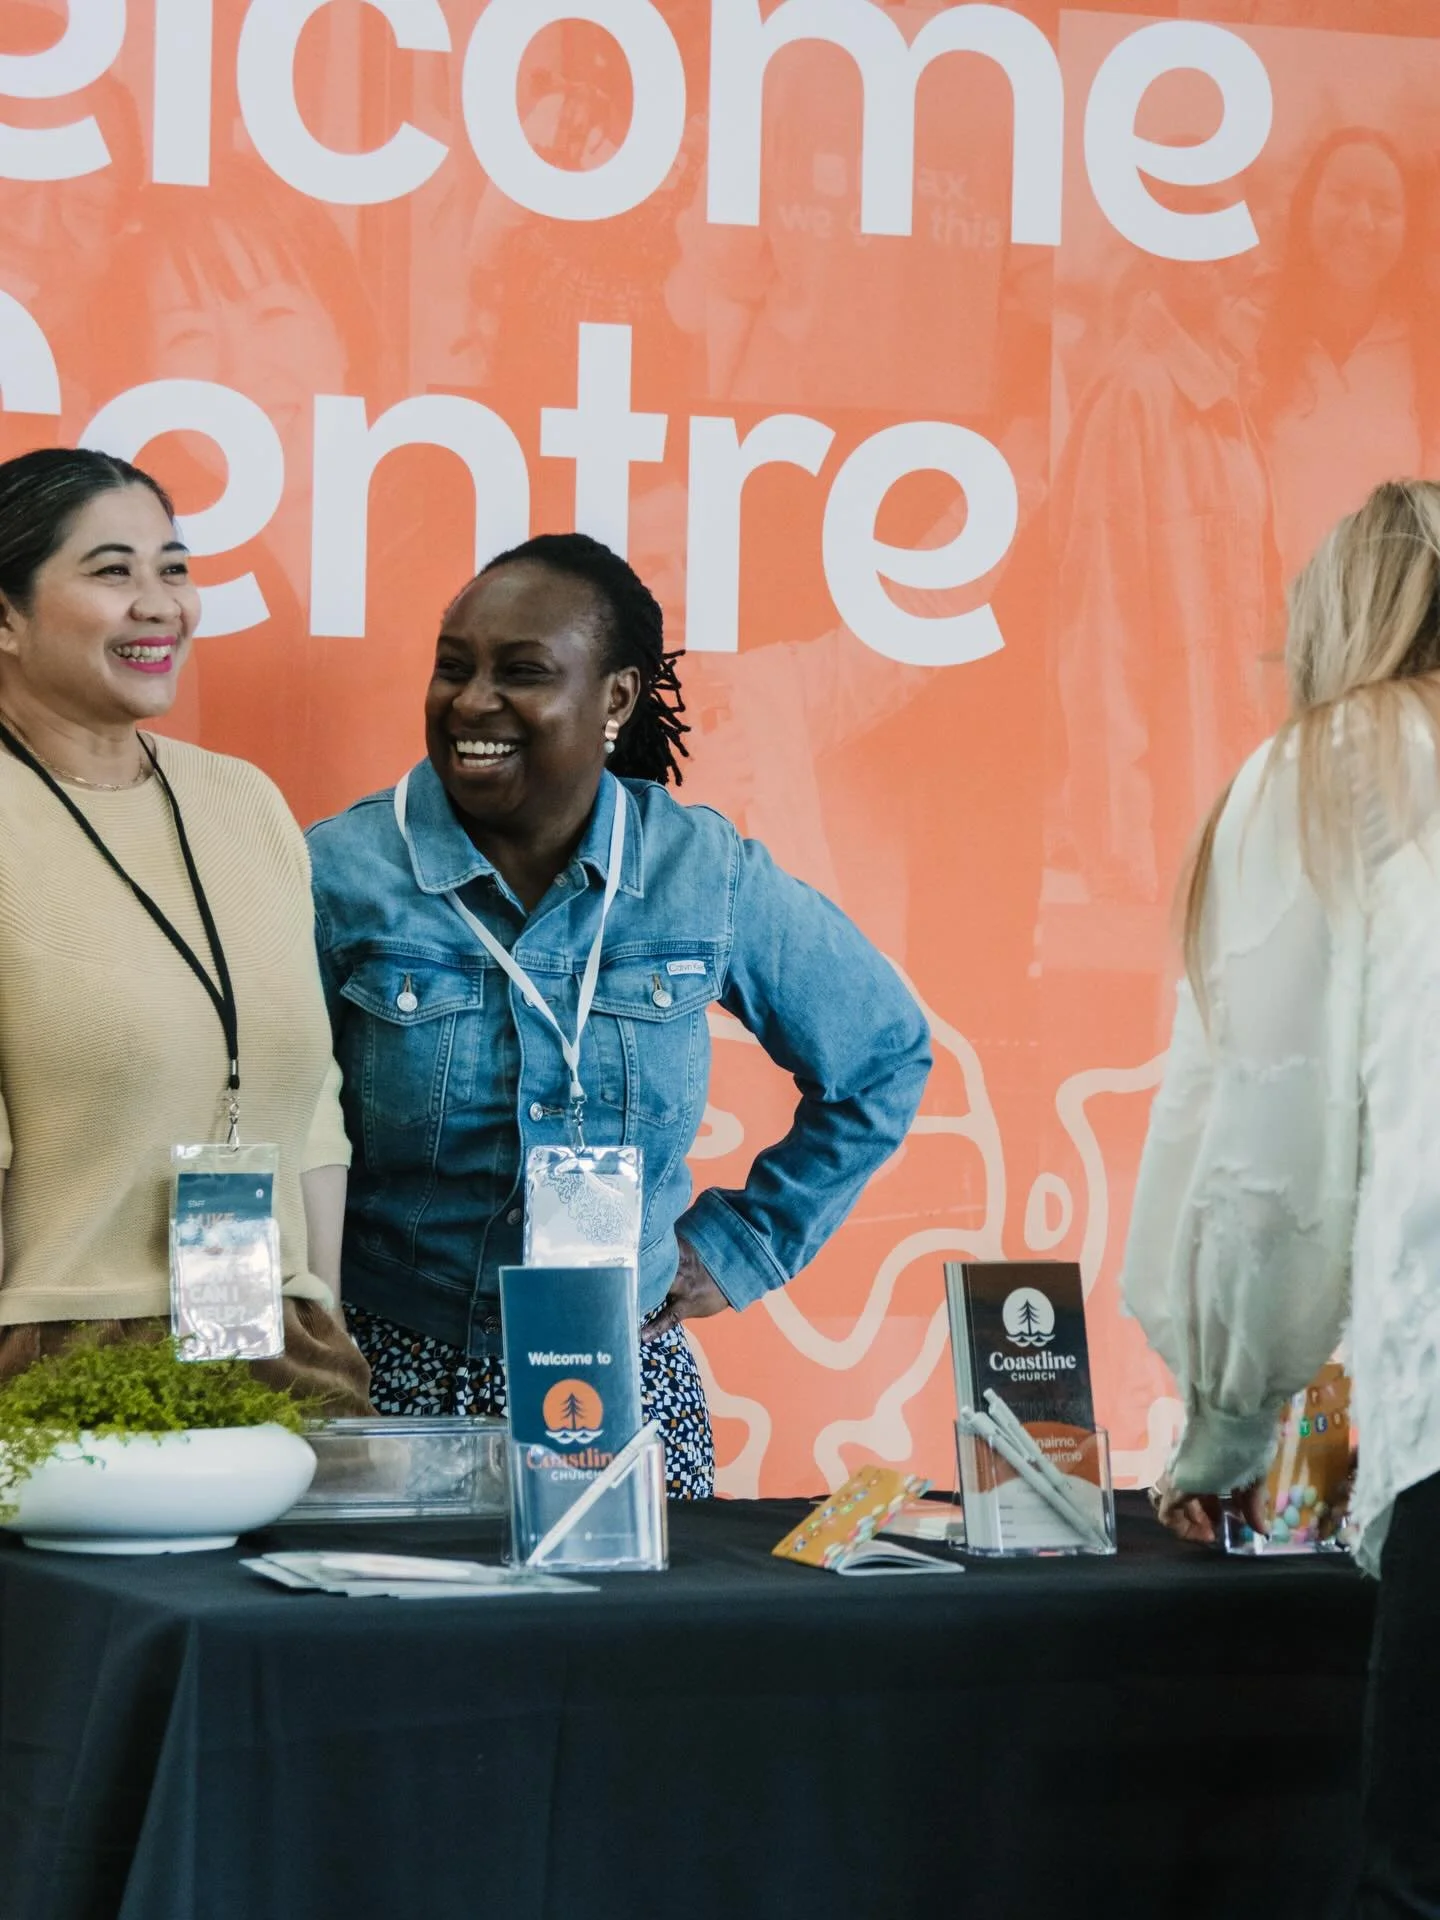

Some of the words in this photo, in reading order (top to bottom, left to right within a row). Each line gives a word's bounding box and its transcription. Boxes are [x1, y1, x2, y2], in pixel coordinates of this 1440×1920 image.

[0, 0, 1275, 263] elcome
[528, 1351, 593, 1366] Welcome
[596, 1351, 612, 1366] to
[988, 1351, 1077, 1372] Coastline
[1010, 1372, 1057, 1382] CHURCH
[526, 1447, 615, 1470] Coastlin
